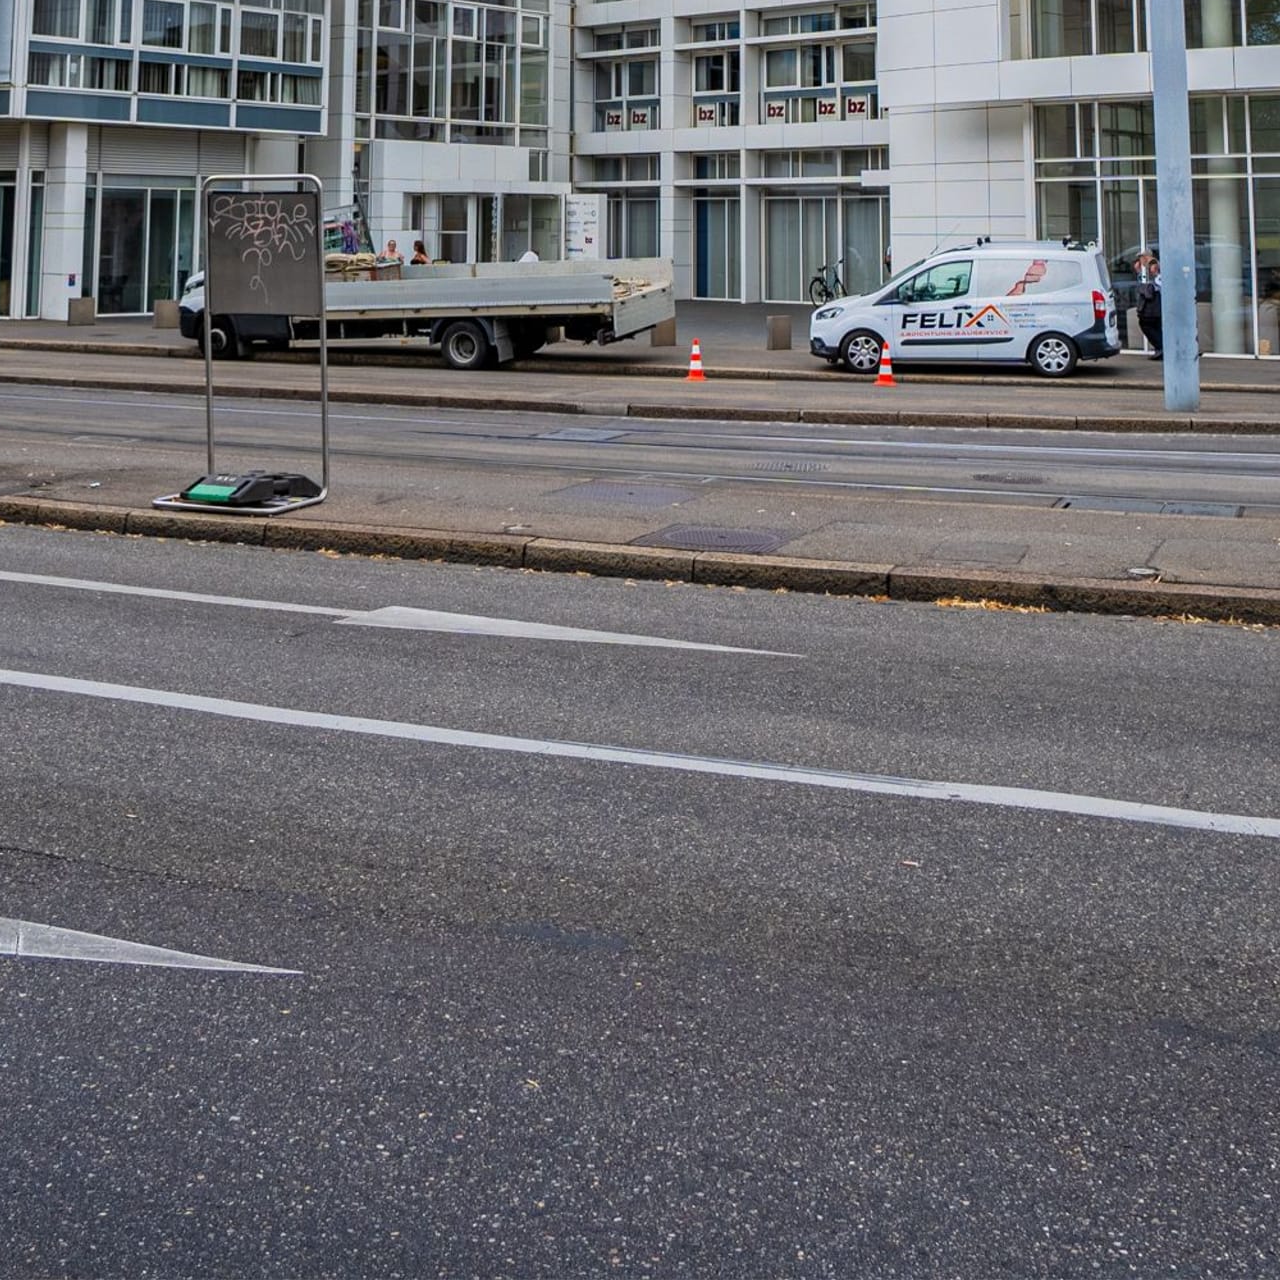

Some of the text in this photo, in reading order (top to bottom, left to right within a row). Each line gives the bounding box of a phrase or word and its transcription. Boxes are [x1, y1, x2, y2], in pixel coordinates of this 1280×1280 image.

[767, 103, 784, 118] bz
[818, 100, 836, 115] bz
[847, 98, 866, 114] bz
[606, 112, 621, 125] bz
[632, 111, 647, 124] bz
[698, 107, 714, 121] bz
[901, 312, 985, 329] FELIX
